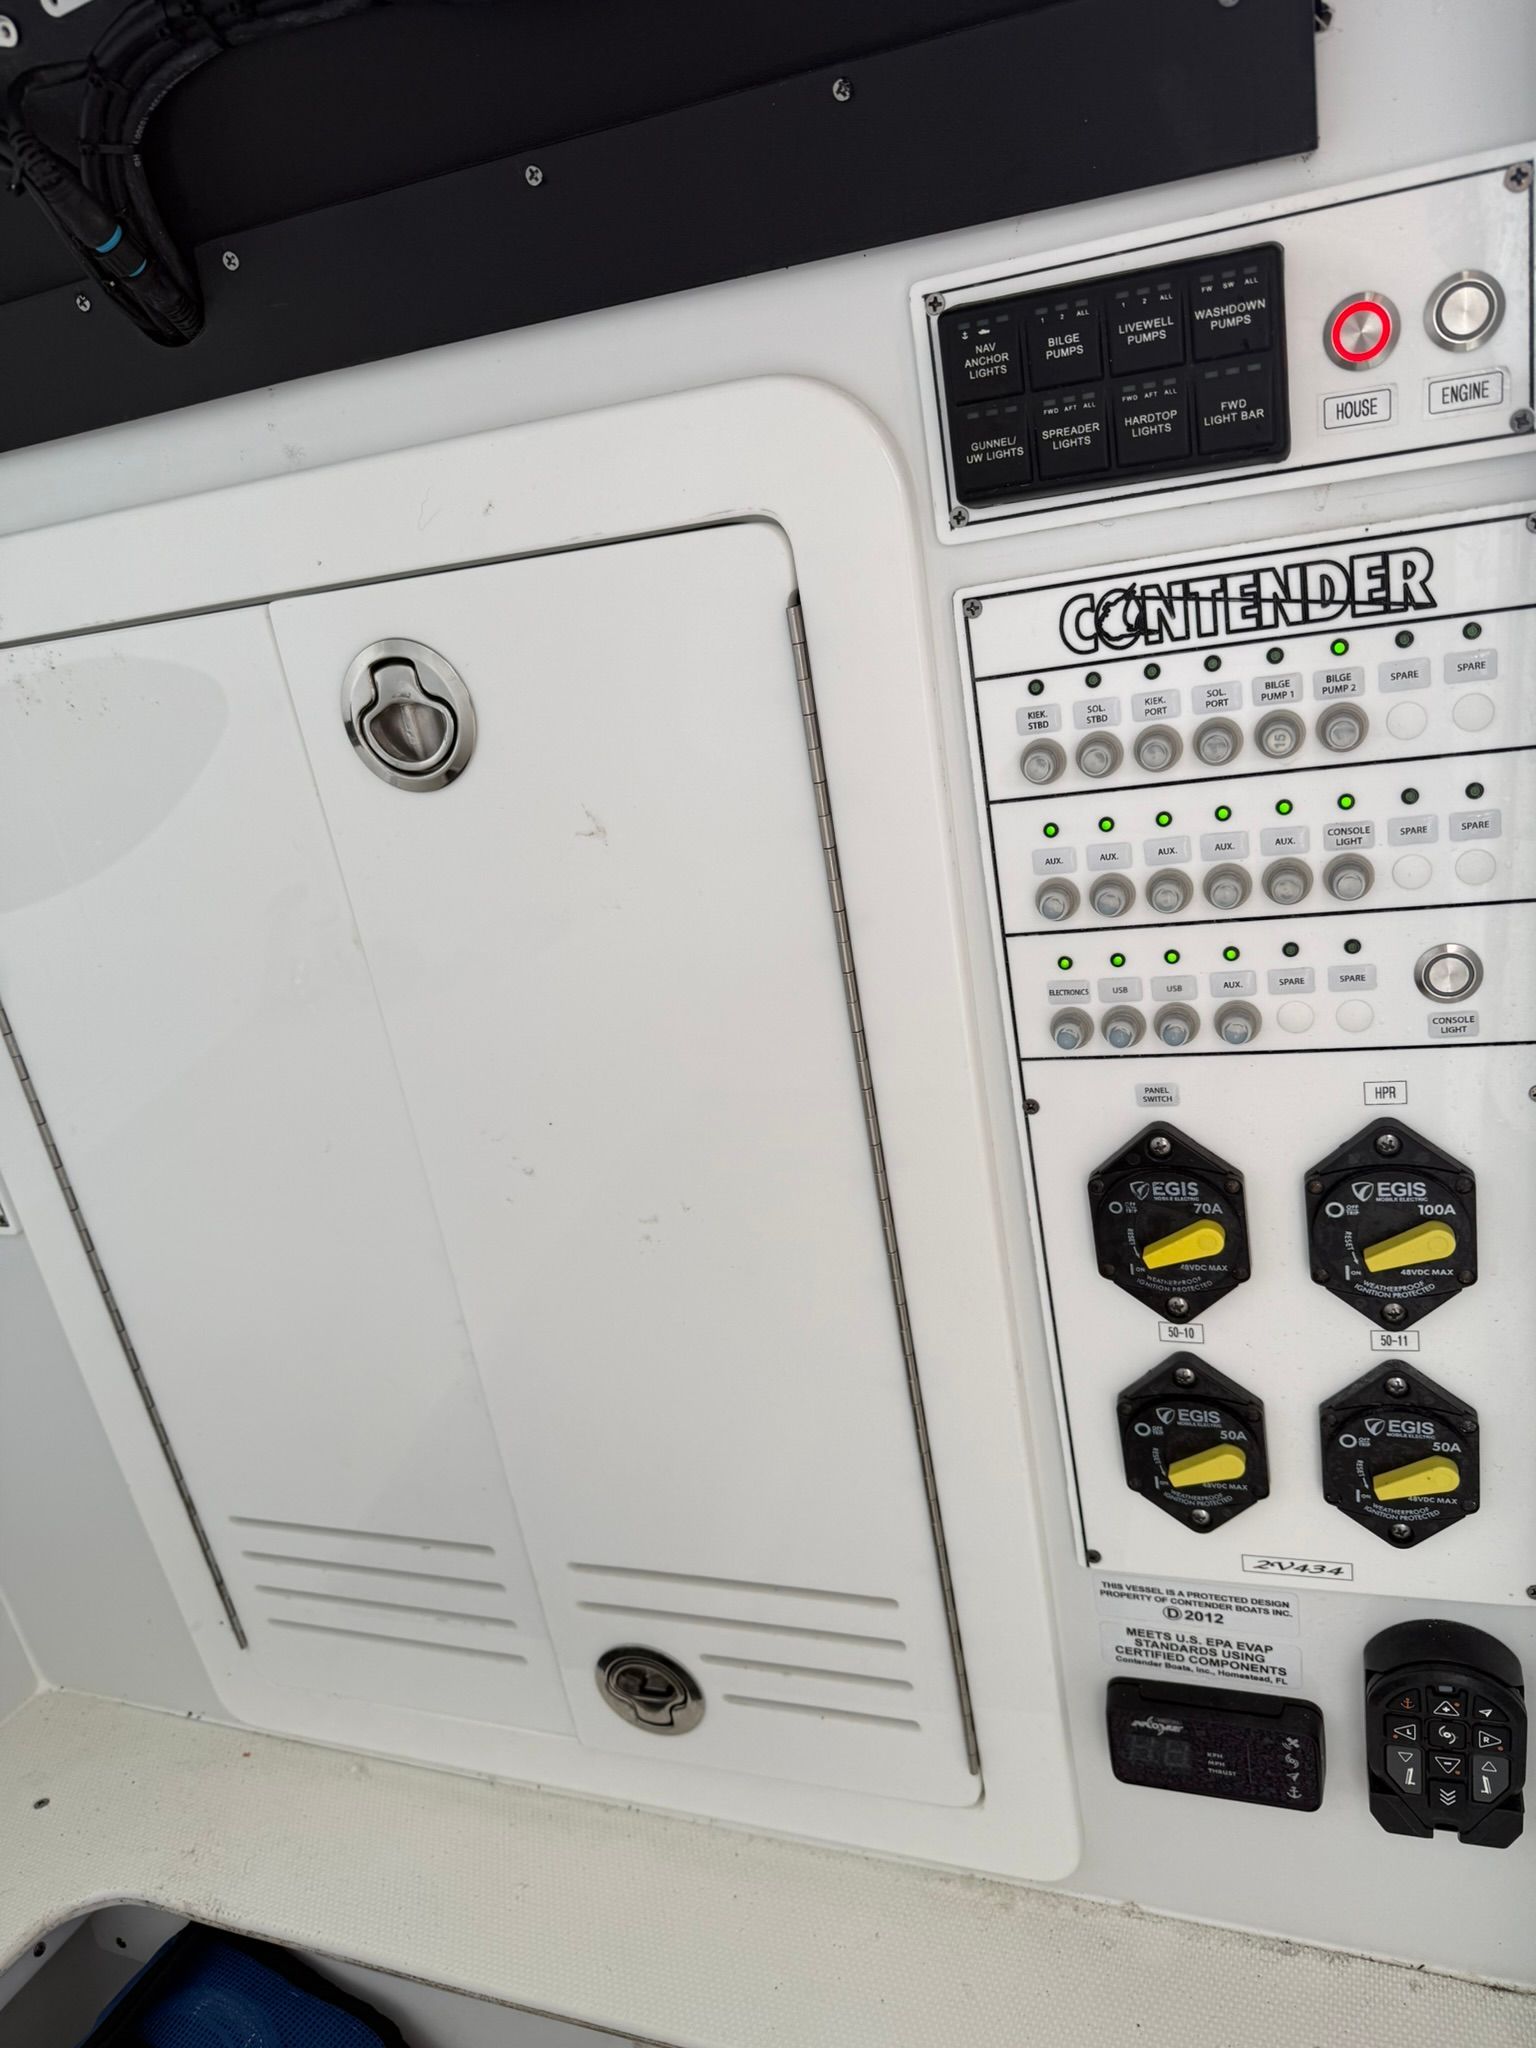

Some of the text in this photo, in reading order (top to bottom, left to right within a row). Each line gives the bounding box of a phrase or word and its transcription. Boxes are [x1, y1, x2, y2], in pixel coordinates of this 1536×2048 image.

[1201, 277, 1259, 293] FW SW ALL
[1160, 292, 1173, 301] ALL
[1076, 308, 1090, 318] ALL
[1194, 299, 1266, 321] WASHDOWN
[1118, 316, 1174, 334] LIVEWELL
[1210, 314, 1251, 330] PUMPS
[1047, 332, 1080, 348] BILGE
[1127, 329, 1167, 345] PUMPS
[975, 342, 996, 355] NAV
[1045, 345, 1084, 360] PUMPS
[964, 352, 1009, 369] ANCHOR
[969, 365, 1007, 380] LIGHTS
[1122, 387, 1177, 403] FWD AFT ALL
[1442, 380, 1489, 404] ENGINE
[1043, 400, 1096, 416] FWD AFT ALL
[1220, 398, 1247, 412] FWD
[1336, 398, 1378, 420] HOUSE
[1124, 409, 1178, 427] HARDTOP
[1204, 408, 1265, 427] LIGHT BAR
[1041, 422, 1100, 441] SPREADER
[1131, 423, 1172, 438] LIGHTS
[970, 436, 1017, 452] GUNNEL/
[1052, 435, 1092, 451] LIGHTS
[966, 446, 1024, 464] UW LIGHTS
[1059, 547, 1437, 654] CONTENDER
[1457, 661, 1486, 672] SPARE
[1325, 672, 1352, 683] BILGE
[1390, 670, 1419, 681] SPARE
[1264, 679, 1291, 690] BILGE
[1322, 684, 1356, 695] PUMP 2
[1206, 689, 1226, 698] SOL.
[1261, 690, 1295, 702] PUMP 1
[1144, 696, 1166, 706] KIEK.
[1205, 698, 1229, 708] PORT
[1027, 710, 1048, 720] KIEK.
[1087, 704, 1106, 714] SOL.
[1144, 706, 1168, 717] PORT
[1086, 714, 1108, 724] STBD
[1028, 721, 1049, 730] STBD
[1274, 733, 1286, 748] 15
[1327, 826, 1371, 836] CONSOLE
[1400, 826, 1428, 836] SPARE
[1461, 820, 1489, 831] SPARE
[1215, 842, 1235, 851] AUX.
[1275, 836, 1296, 846] AUX.
[1336, 837, 1362, 846] LIGHT
[1100, 853, 1119, 861] AUX.
[1158, 847, 1178, 856] AUX.
[1045, 857, 1063, 866] AUX.
[1279, 977, 1305, 986] SPARE
[1339, 973, 1366, 982] SPARE
[1112, 986, 1128, 994] USB
[1166, 985, 1182, 993] USB
[1223, 981, 1243, 989] AUX.
[1049, 988, 1089, 996] ELECTRONICS
[1432, 1015, 1475, 1025] CONSOLE
[1440, 1025, 1467, 1034] LIGHT
[1144, 1087, 1169, 1095] PANEL
[1375, 1086, 1396, 1099] HPR
[1143, 1095, 1173, 1103] SWITCH
[1152, 1181, 1199, 1196] EGIS
[1377, 1182, 1427, 1197] EGIS
[1193, 1203, 1223, 1214] 70A
[1418, 1204, 1456, 1215] 100A
[1344, 1231, 1355, 1250] RESET
[1136, 1278, 1213, 1292] IGNITION PROTECTED
[1354, 1283, 1435, 1298] IGNITION PROTECTED
[1363, 1280, 1425, 1292] WEATHERPROOF
[1168, 1326, 1194, 1338] 50-10
[1380, 1335, 1408, 1346] 50-11
[1177, 1408, 1221, 1423] EGIS
[1388, 1420, 1435, 1435] EGIS
[1220, 1430, 1247, 1440] 50A
[1432, 1442, 1462, 1453] 50A
[1356, 1460, 1365, 1476] RESET
[1364, 1505, 1440, 1521] IGNITION PROTECTED
[1373, 1503, 1430, 1515] WEATHERPROOF
[1101, 1581, 1123, 1590] THIS
[1125, 1584, 1164, 1595] VESSEL
[1186, 1591, 1248, 1604] PROTECTED
[1250, 1598, 1290, 1608] DESIGN
[1100, 1589, 1152, 1601] PROPERTY
[1170, 1598, 1232, 1611] CONTENDER
[1235, 1605, 1270, 1614] BOATS
[1272, 1609, 1293, 1618] INC.
[1184, 1610, 1224, 1624] 2012
[1126, 1627, 1273, 1654] MEETS U.S. EPA EVAP
[1134, 1638, 1265, 1663] STANDARDS USING
[1115, 1645, 1287, 1676] CERTIFIED COMPONENTS
[1115, 1655, 1162, 1667] Contender
[1164, 1661, 1193, 1673] Boats,
[1218, 1670, 1273, 1684] Homestead,
[1276, 1677, 1288, 1685] FL
